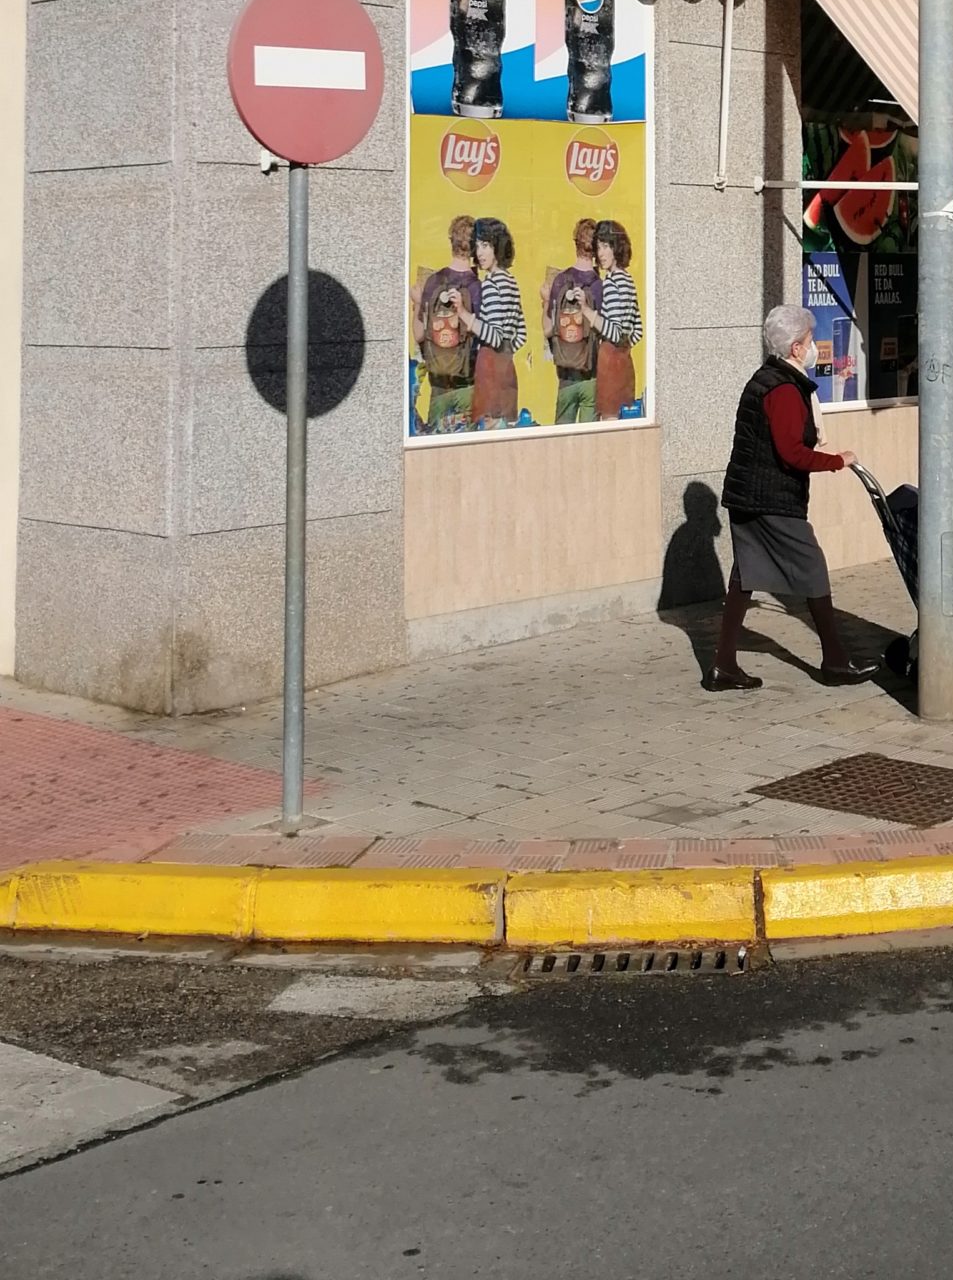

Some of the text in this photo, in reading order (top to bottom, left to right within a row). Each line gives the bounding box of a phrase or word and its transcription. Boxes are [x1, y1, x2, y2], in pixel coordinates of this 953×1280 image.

[581, 13, 599, 23] pepsi
[444, 134, 498, 176] Lay's
[569, 141, 617, 181] Lay's
[807, 264, 841, 277] RED BULL
[874, 264, 904, 276] RED BULL
[807, 279, 829, 292] TE DA
[875, 278, 893, 290] TE DA
